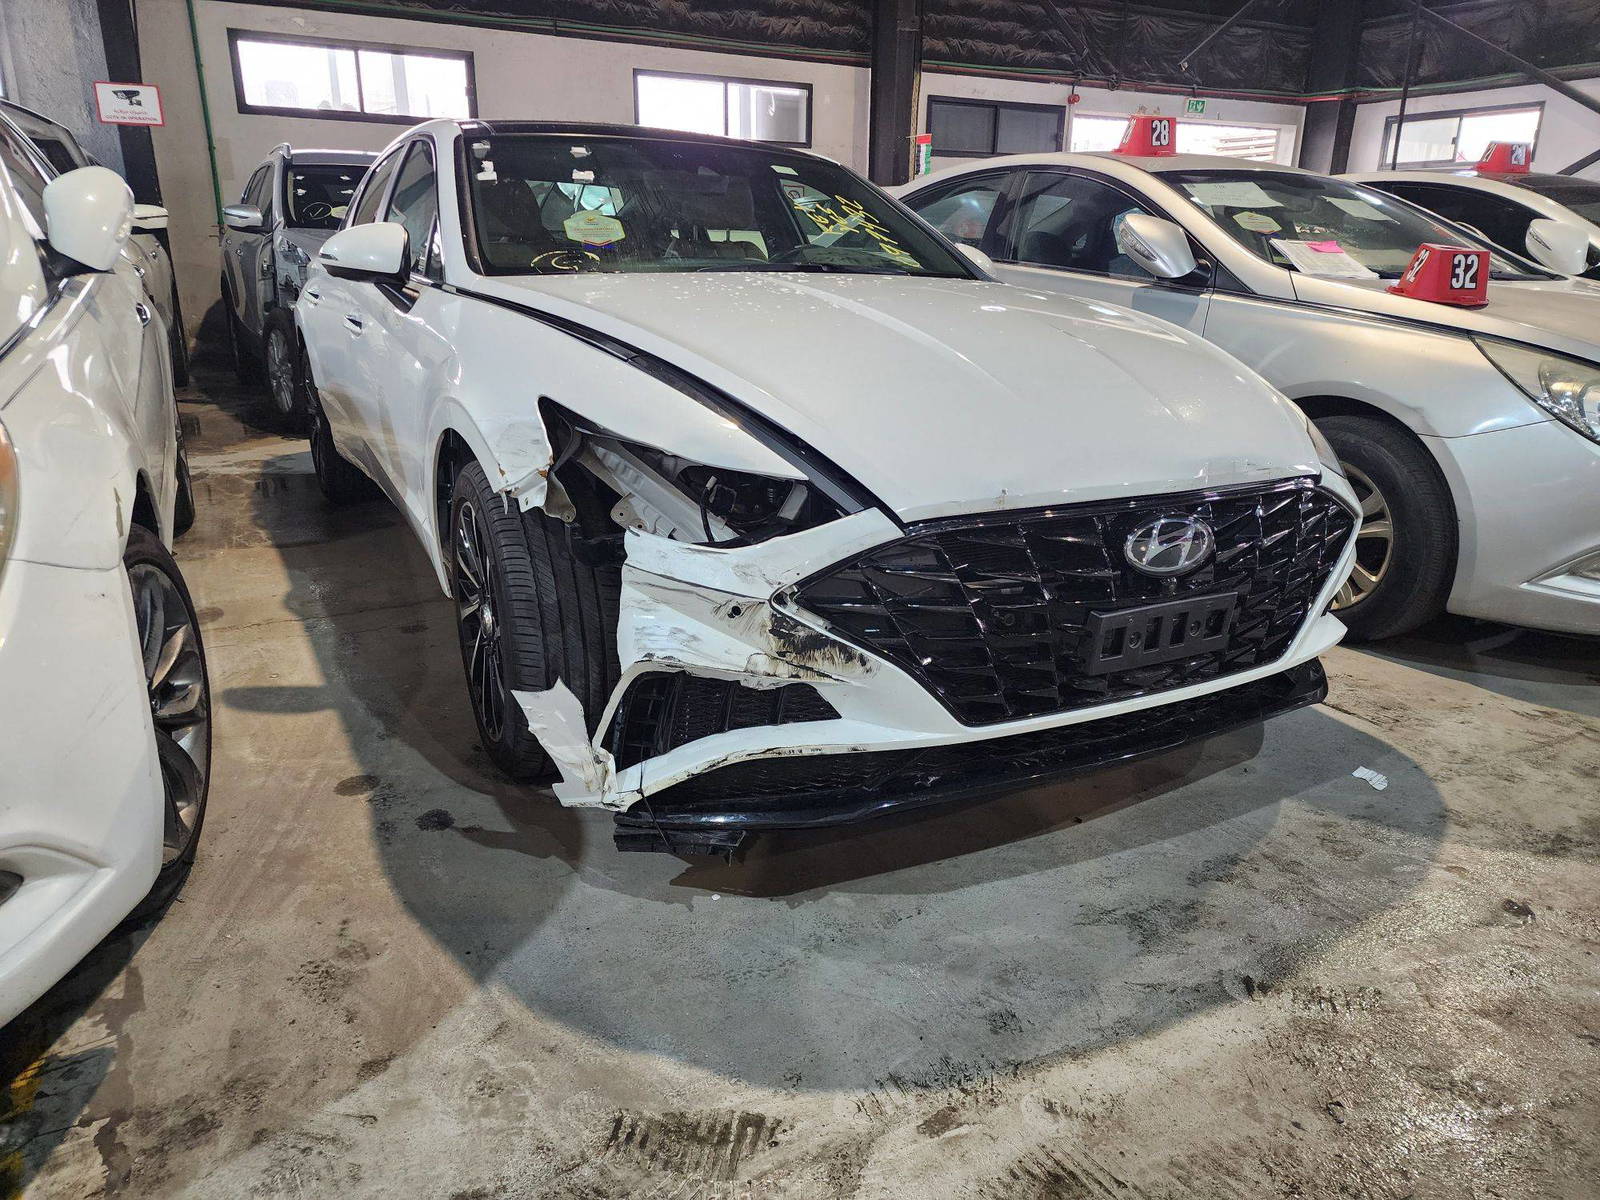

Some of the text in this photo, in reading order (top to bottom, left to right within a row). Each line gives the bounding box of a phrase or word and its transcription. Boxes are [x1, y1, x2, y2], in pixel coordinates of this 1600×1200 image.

[1152, 119, 1170, 146] 28
[1406, 249, 1431, 283] 32
[1451, 254, 1479, 289] 32
